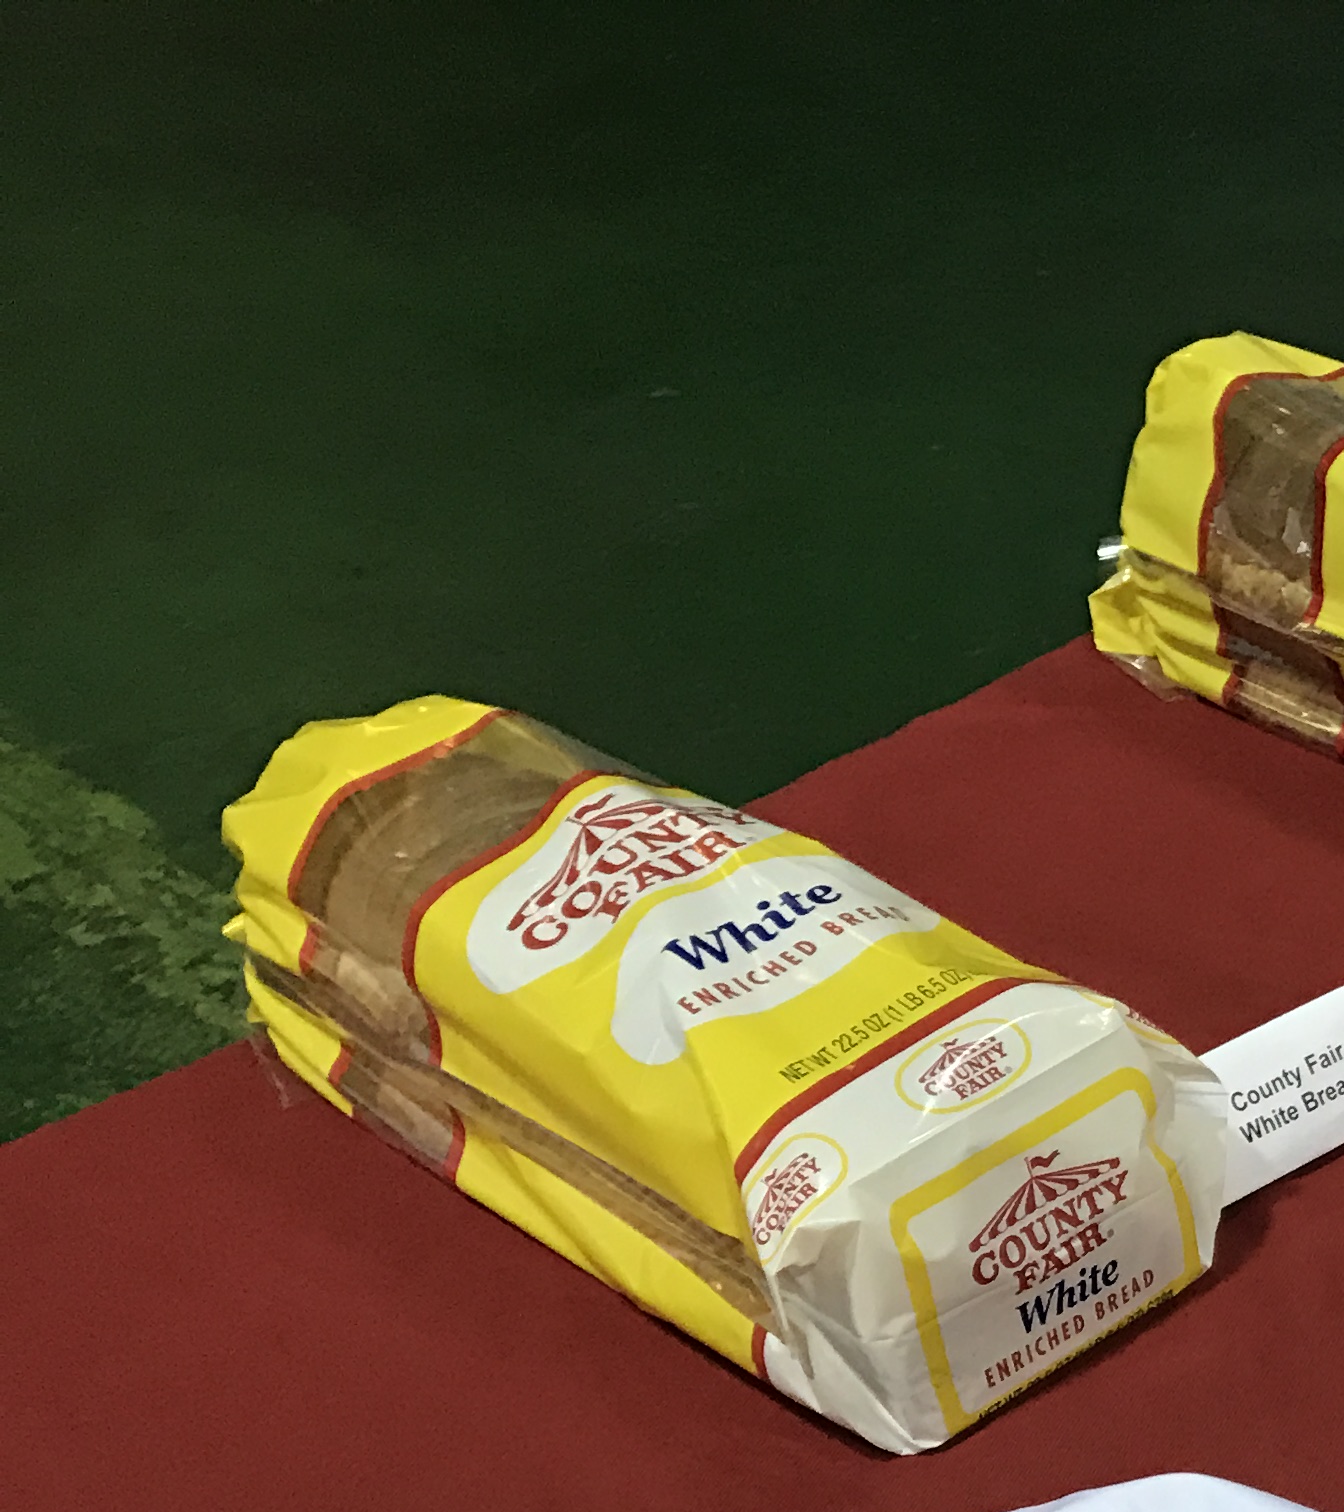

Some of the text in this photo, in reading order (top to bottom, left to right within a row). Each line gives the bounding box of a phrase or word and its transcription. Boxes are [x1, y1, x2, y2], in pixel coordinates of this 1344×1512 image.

[521, 807, 757, 950] COUNTY
[595, 830, 747, 923] FAIR
[662, 882, 842, 971] White
[677, 904, 911, 1016] ENRICHED BREAD
[779, 1055, 811, 1084] NET
[809, 1045, 839, 1068] WT
[831, 1025, 871, 1055] 22.5
[862, 1012, 891, 1034] OZ
[896, 991, 925, 1012] LB
[916, 976, 947, 999] 6.5
[951, 1066, 1007, 1101] FAIR
[1230, 1043, 1344, 1112] County Fair
[1238, 1106, 1300, 1144] White
[755, 1156, 822, 1246] COUNTY
[970, 1169, 1129, 1286] COUNTY
[1013, 1222, 1107, 1296] FAIR
[1015, 1258, 1120, 1335] White
[983, 1313, 1085, 1389] ENRICHED
[1094, 1268, 1156, 1321] BREAD
